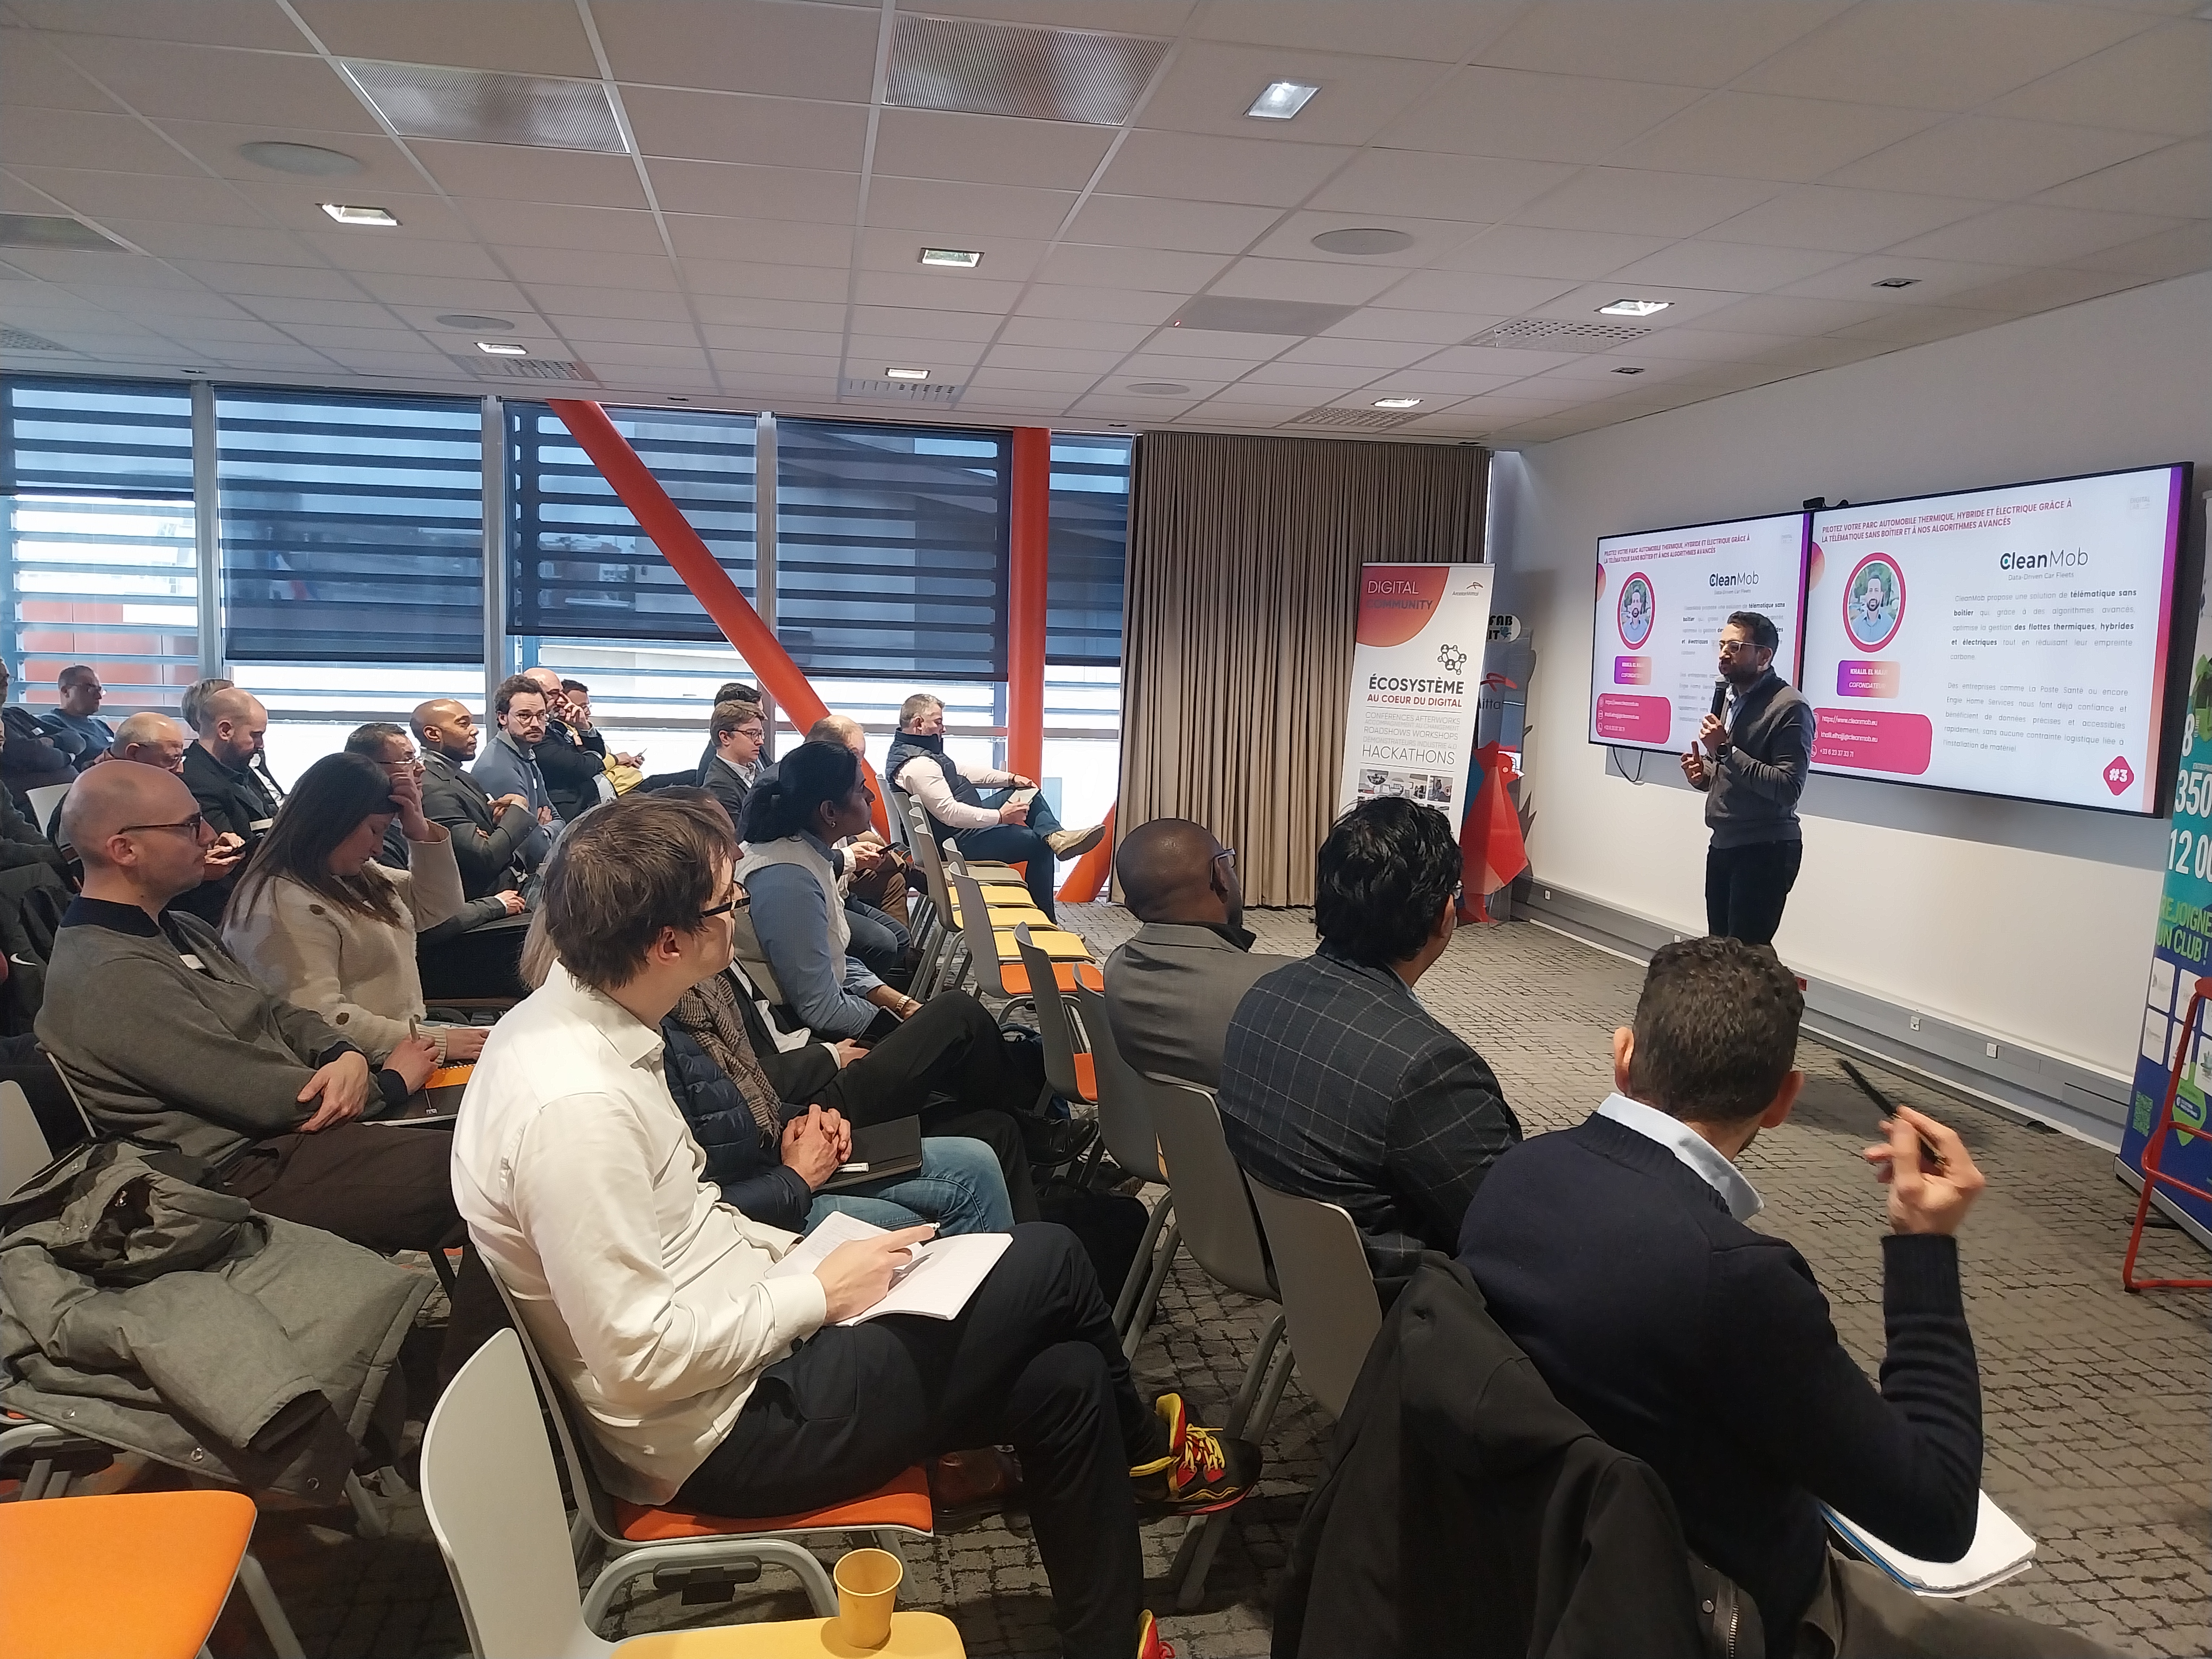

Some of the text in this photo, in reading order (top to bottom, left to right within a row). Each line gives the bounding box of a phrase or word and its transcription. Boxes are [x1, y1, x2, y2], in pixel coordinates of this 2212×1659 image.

[1823, 525, 1843, 533] PILOTEZ
[1844, 523, 1862, 531] VOTRE
[1863, 522, 1878, 530] PARC
[1879, 517, 1917, 528] AUTOMOBILE
[1957, 510, 1985, 519] HYBRIDE
[1996, 504, 2037, 516] ÉLECTRIQUE
[2039, 500, 2065, 511] GRÂCE
[2067, 498, 2072, 508] À
[1829, 532, 1864, 542] TÉLÉMATIQUE
[1866, 530, 1880, 538] SANS
[1918, 526, 1931, 534] NOS
[1932, 521, 1977, 532] ALGORITHMES
[1978, 516, 2011, 528] AVANCÉS
[2001, 547, 2088, 570] CleanMob
[1710, 570, 1759, 587] CleanMob
[1368, 581, 1419, 595] DIGITAL
[2070, 590, 2115, 599] télématique
[1367, 600, 1433, 610] COMMUNITY
[2053, 607, 2094, 616] algorithmes
[1989, 625, 2012, 633] gestion
[2054, 623, 2097, 632] thermiques,
[2100, 622, 2134, 632] hybrides
[1963, 638, 1997, 648] électriques
[1369, 673, 1464, 695] ÉCOSYSTÈME
[1367, 694, 1462, 708] AU COEUR DU DIGITAL
[1947, 697, 1963, 705] Engie
[2078, 703, 2114, 712] confiance
[1365, 719, 1414, 728] ACCOMPAGNEMENT
[1416, 716, 1461, 725] AFTERWORKS
[2033, 717, 2061, 725] précises
[2082, 721, 2125, 729] accessibles
[1364, 726, 1458, 741] ROADSHOWS WORKSHOPS
[2027, 732, 2061, 741] contrainte
[2065, 734, 2100, 744] logistique
[2103, 737, 2116, 745] liée
[1362, 744, 1455, 765] HACKATHONS
[2110, 768, 2128, 782] #3
[2174, 929, 2203, 962] CLUB
